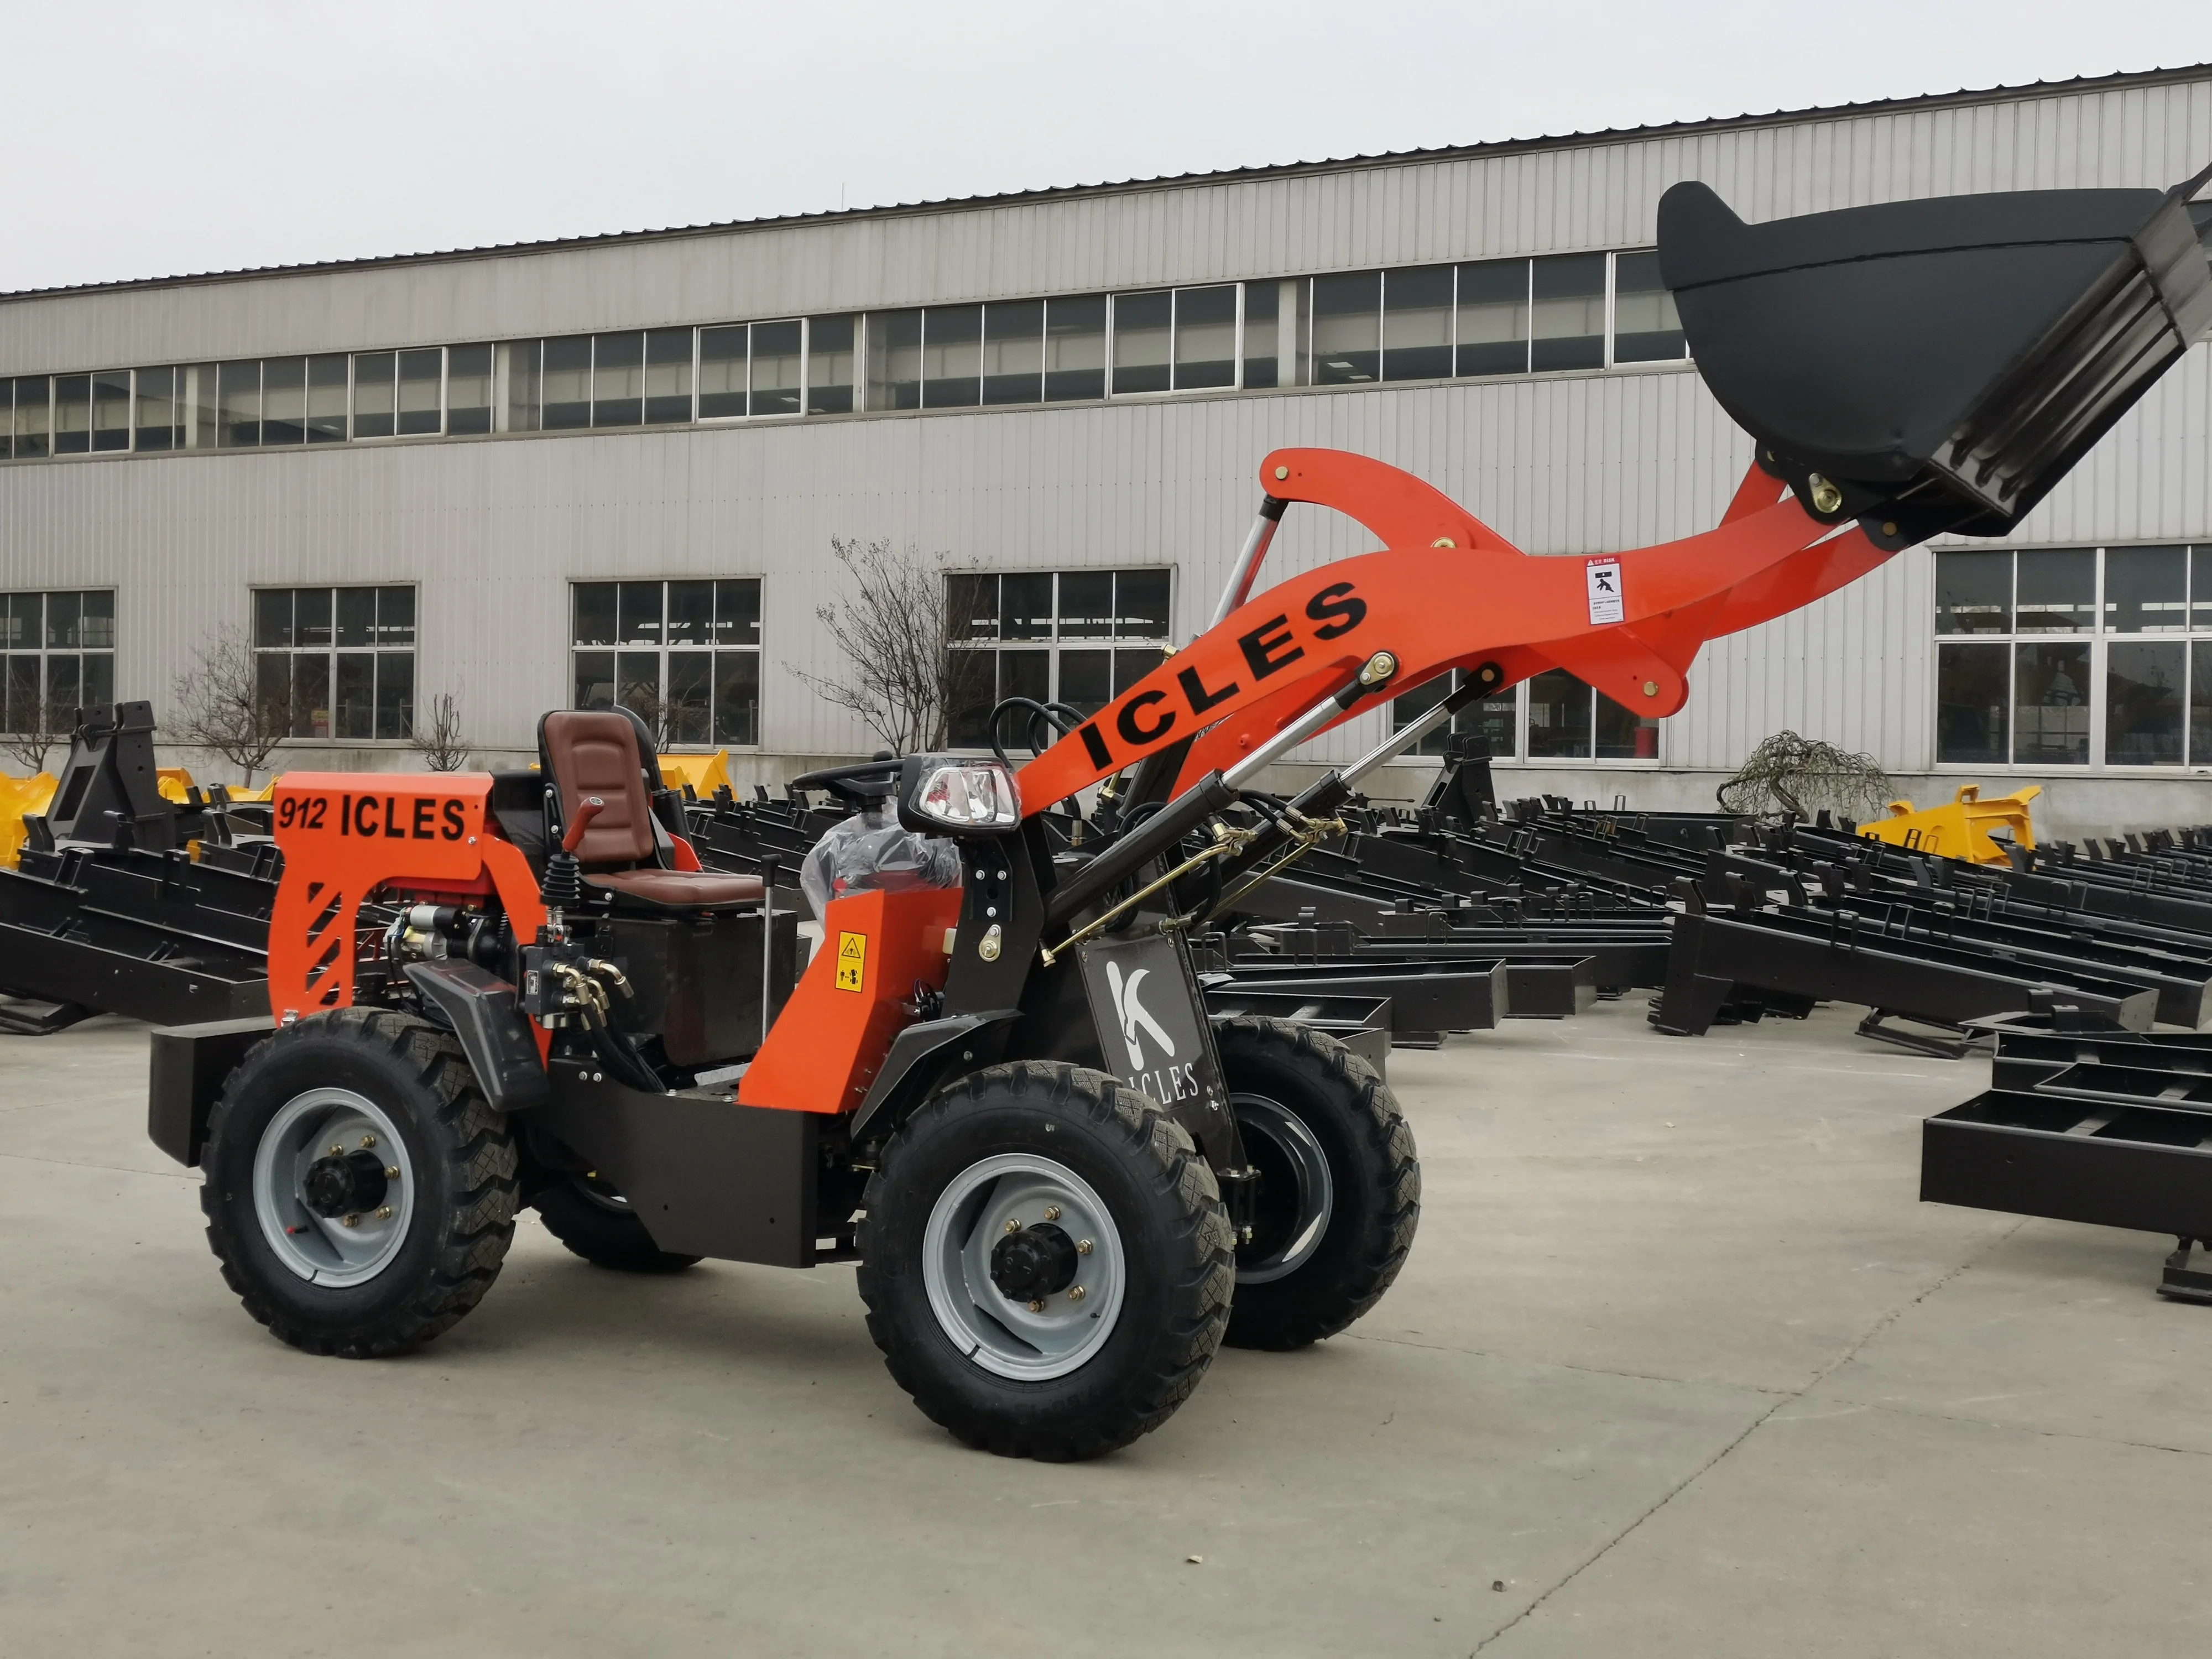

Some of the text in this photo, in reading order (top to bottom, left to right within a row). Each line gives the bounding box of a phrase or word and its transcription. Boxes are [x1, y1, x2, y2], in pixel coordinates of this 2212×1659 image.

[1079, 582, 1367, 772] ICLES
[279, 795, 465, 842] 912 ICLES
